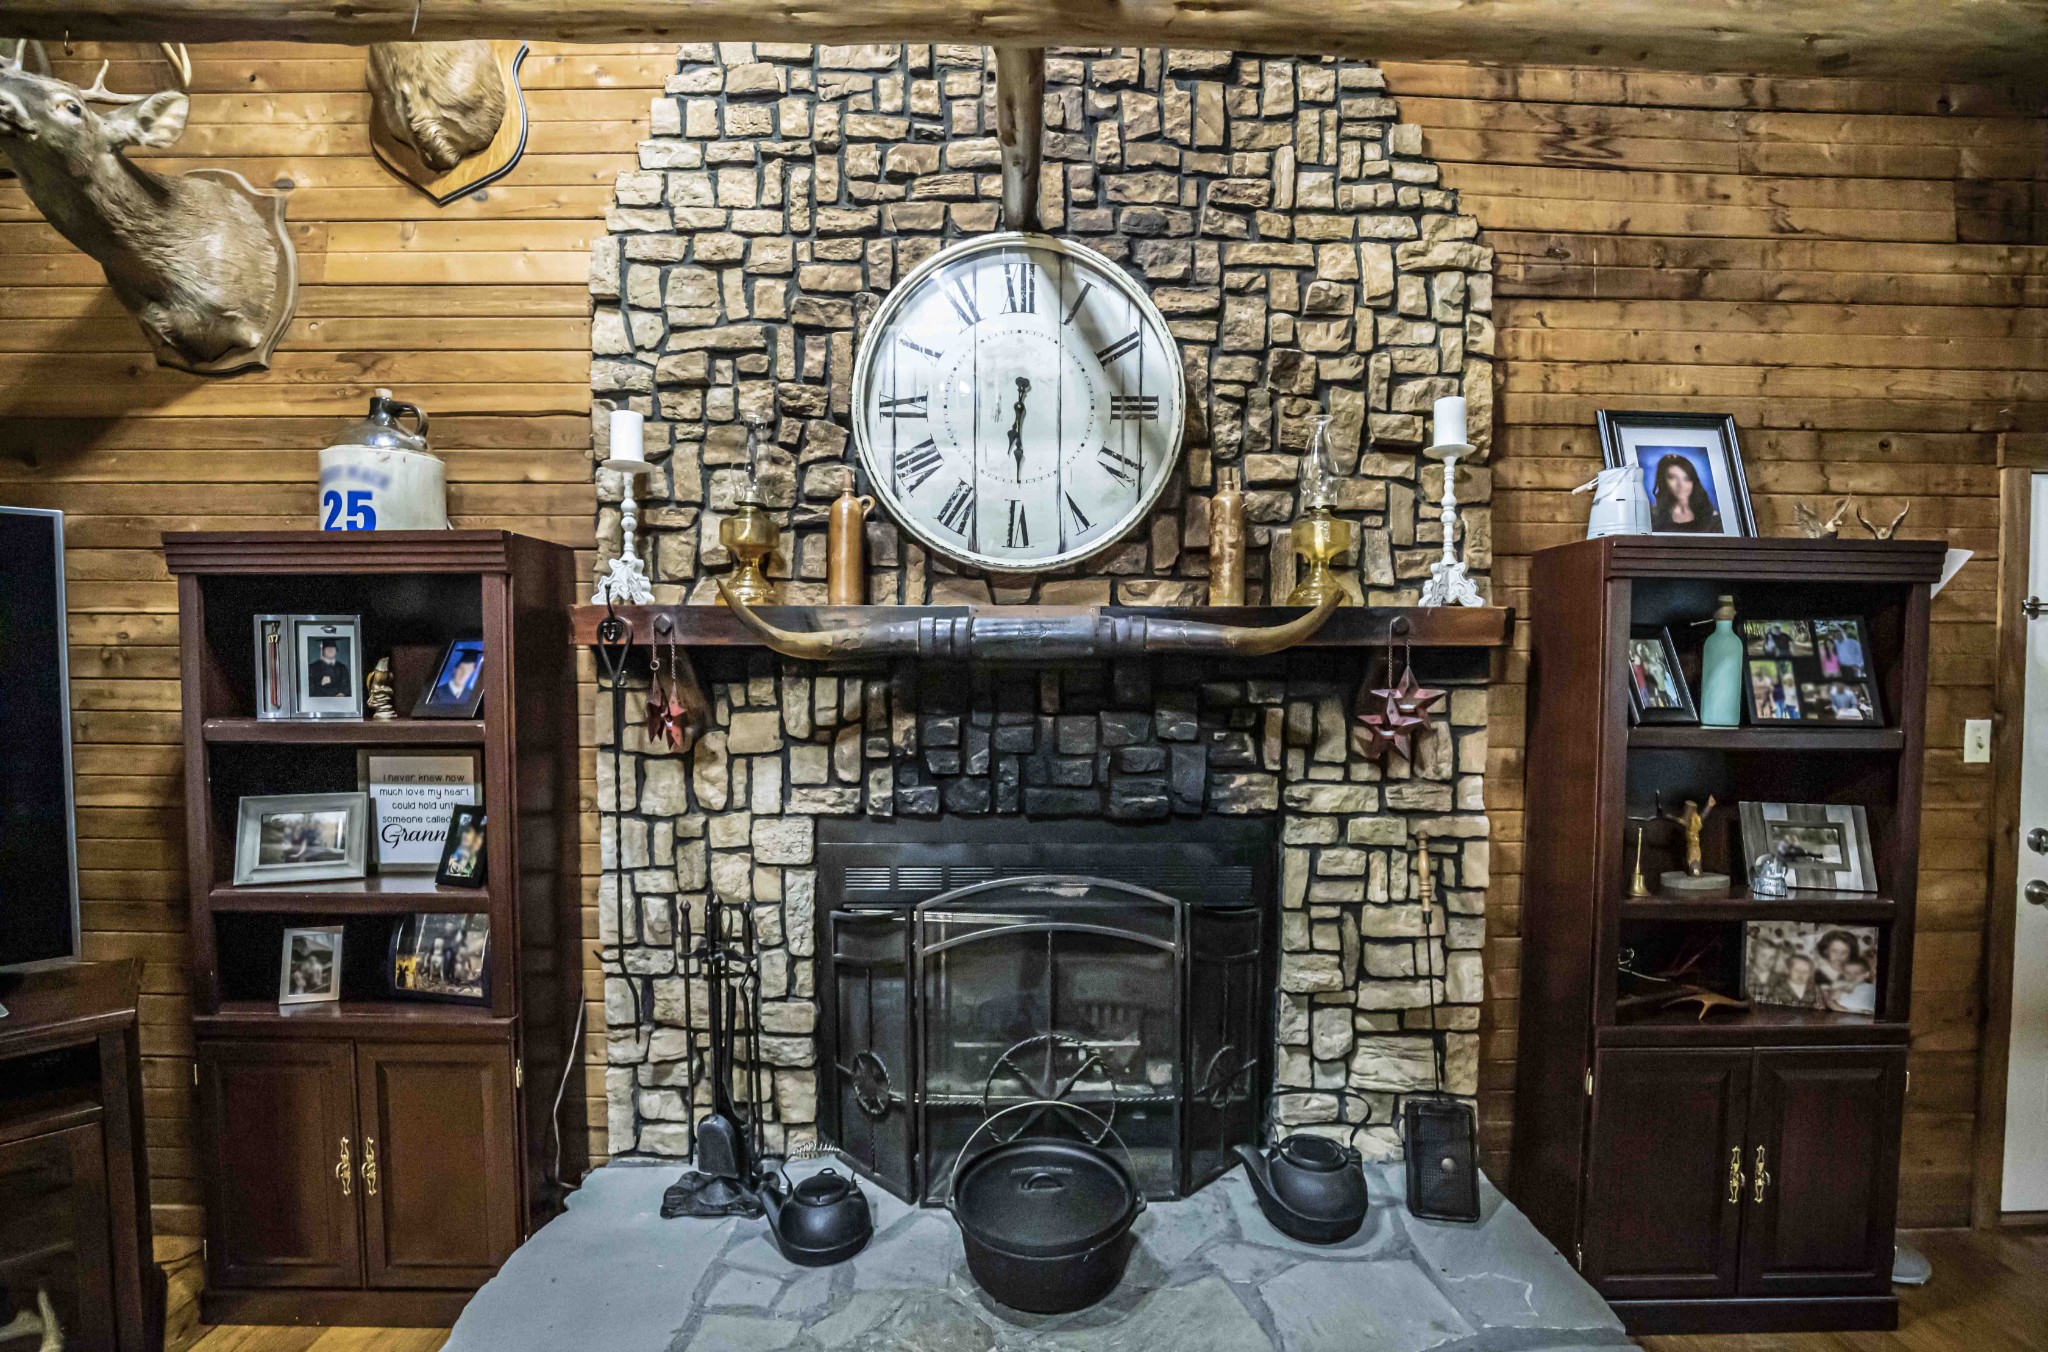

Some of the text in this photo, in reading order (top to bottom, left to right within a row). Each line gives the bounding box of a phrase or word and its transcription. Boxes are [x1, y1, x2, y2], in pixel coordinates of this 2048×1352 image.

[1000, 263, 1040, 315] XII
[1059, 278, 1097, 326] I
[1094, 326, 1147, 371] II
[879, 390, 928, 423] IX
[1110, 392, 1159, 424] III
[895, 433, 945, 498] VIII
[1096, 441, 1148, 494] IV
[323, 490, 377, 531] 25
[934, 477, 974, 537] VII
[1001, 499, 1035, 548] VI
[1064, 491, 1097, 536] V
[379, 787, 469, 799] much love my heart
[387, 774, 416, 782] never
[418, 774, 443, 782] knew
[445, 774, 465, 782] how
[382, 815, 423, 823] someone
[392, 802, 416, 810] could
[418, 802, 437, 810] hold
[381, 823, 446, 849] Grann
